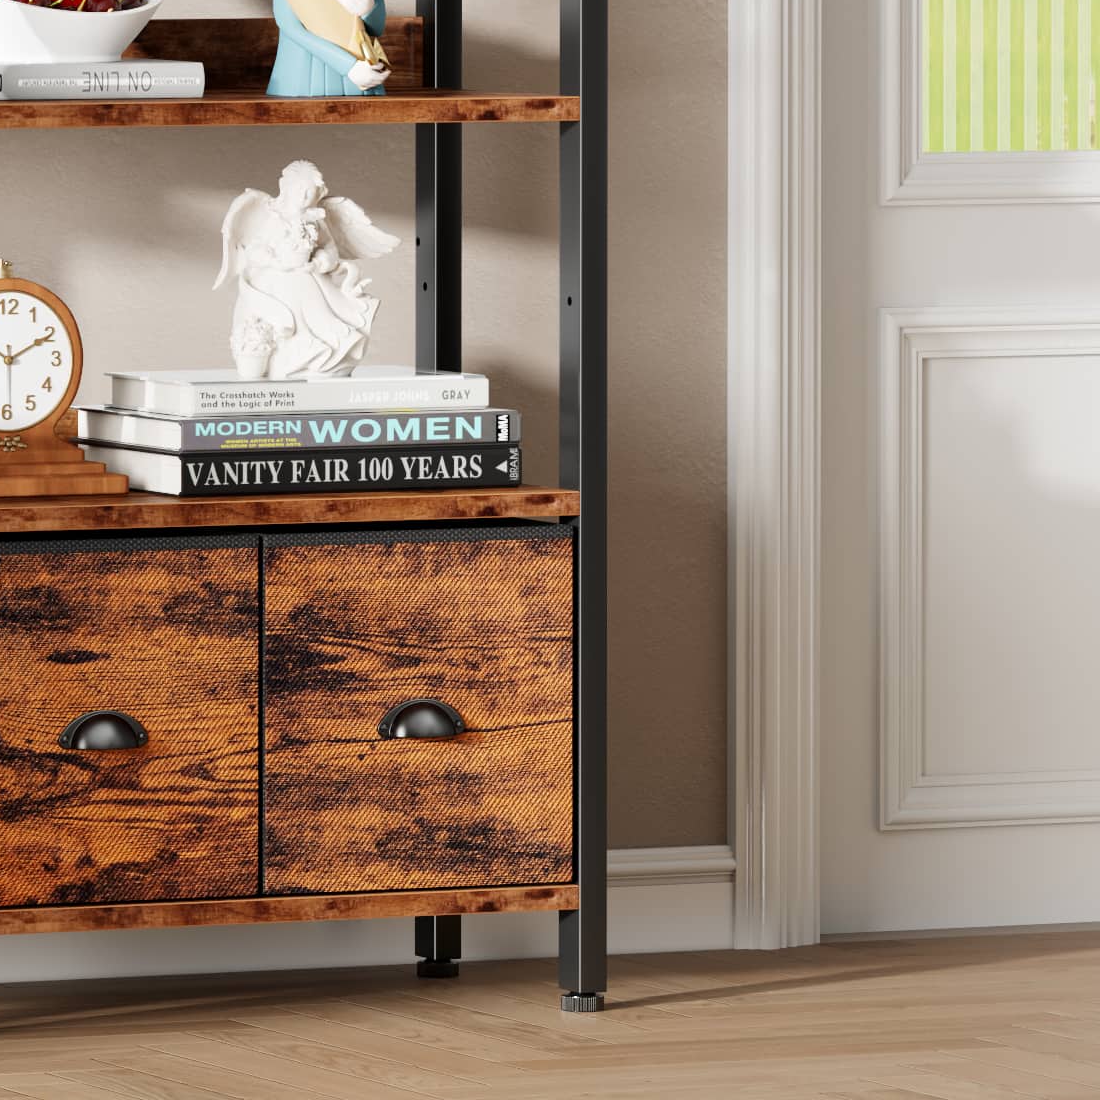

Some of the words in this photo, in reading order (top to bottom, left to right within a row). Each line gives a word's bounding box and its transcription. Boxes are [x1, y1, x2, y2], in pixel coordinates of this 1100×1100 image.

[82, 71, 120, 93] LINE
[128, 71, 152, 92] ON
[29, 306, 37, 323] 1
[44, 326, 56, 342] 2
[51, 351, 62, 367] 3
[41, 376, 52, 392] 4
[25, 395, 36, 411] 5
[200, 391, 216, 400] The
[219, 390, 266, 399] Crosshatch
[268, 390, 295, 398] Works
[441, 389, 471, 401] GRAY
[1, 404, 13, 420] 6
[201, 401, 218, 409] and
[221, 400, 236, 408] the
[239, 399, 260, 409] Logic
[264, 399, 273, 407] of
[275, 399, 295, 407] Print
[195, 420, 302, 437] MODERN
[308, 415, 482, 443] WOMEN
[497, 414, 509, 442] MoMA
[186, 460, 284, 487] VANITY
[290, 458, 350, 484] FAIR
[357, 457, 394, 482] 100
[400, 454, 483, 481] YEARS
